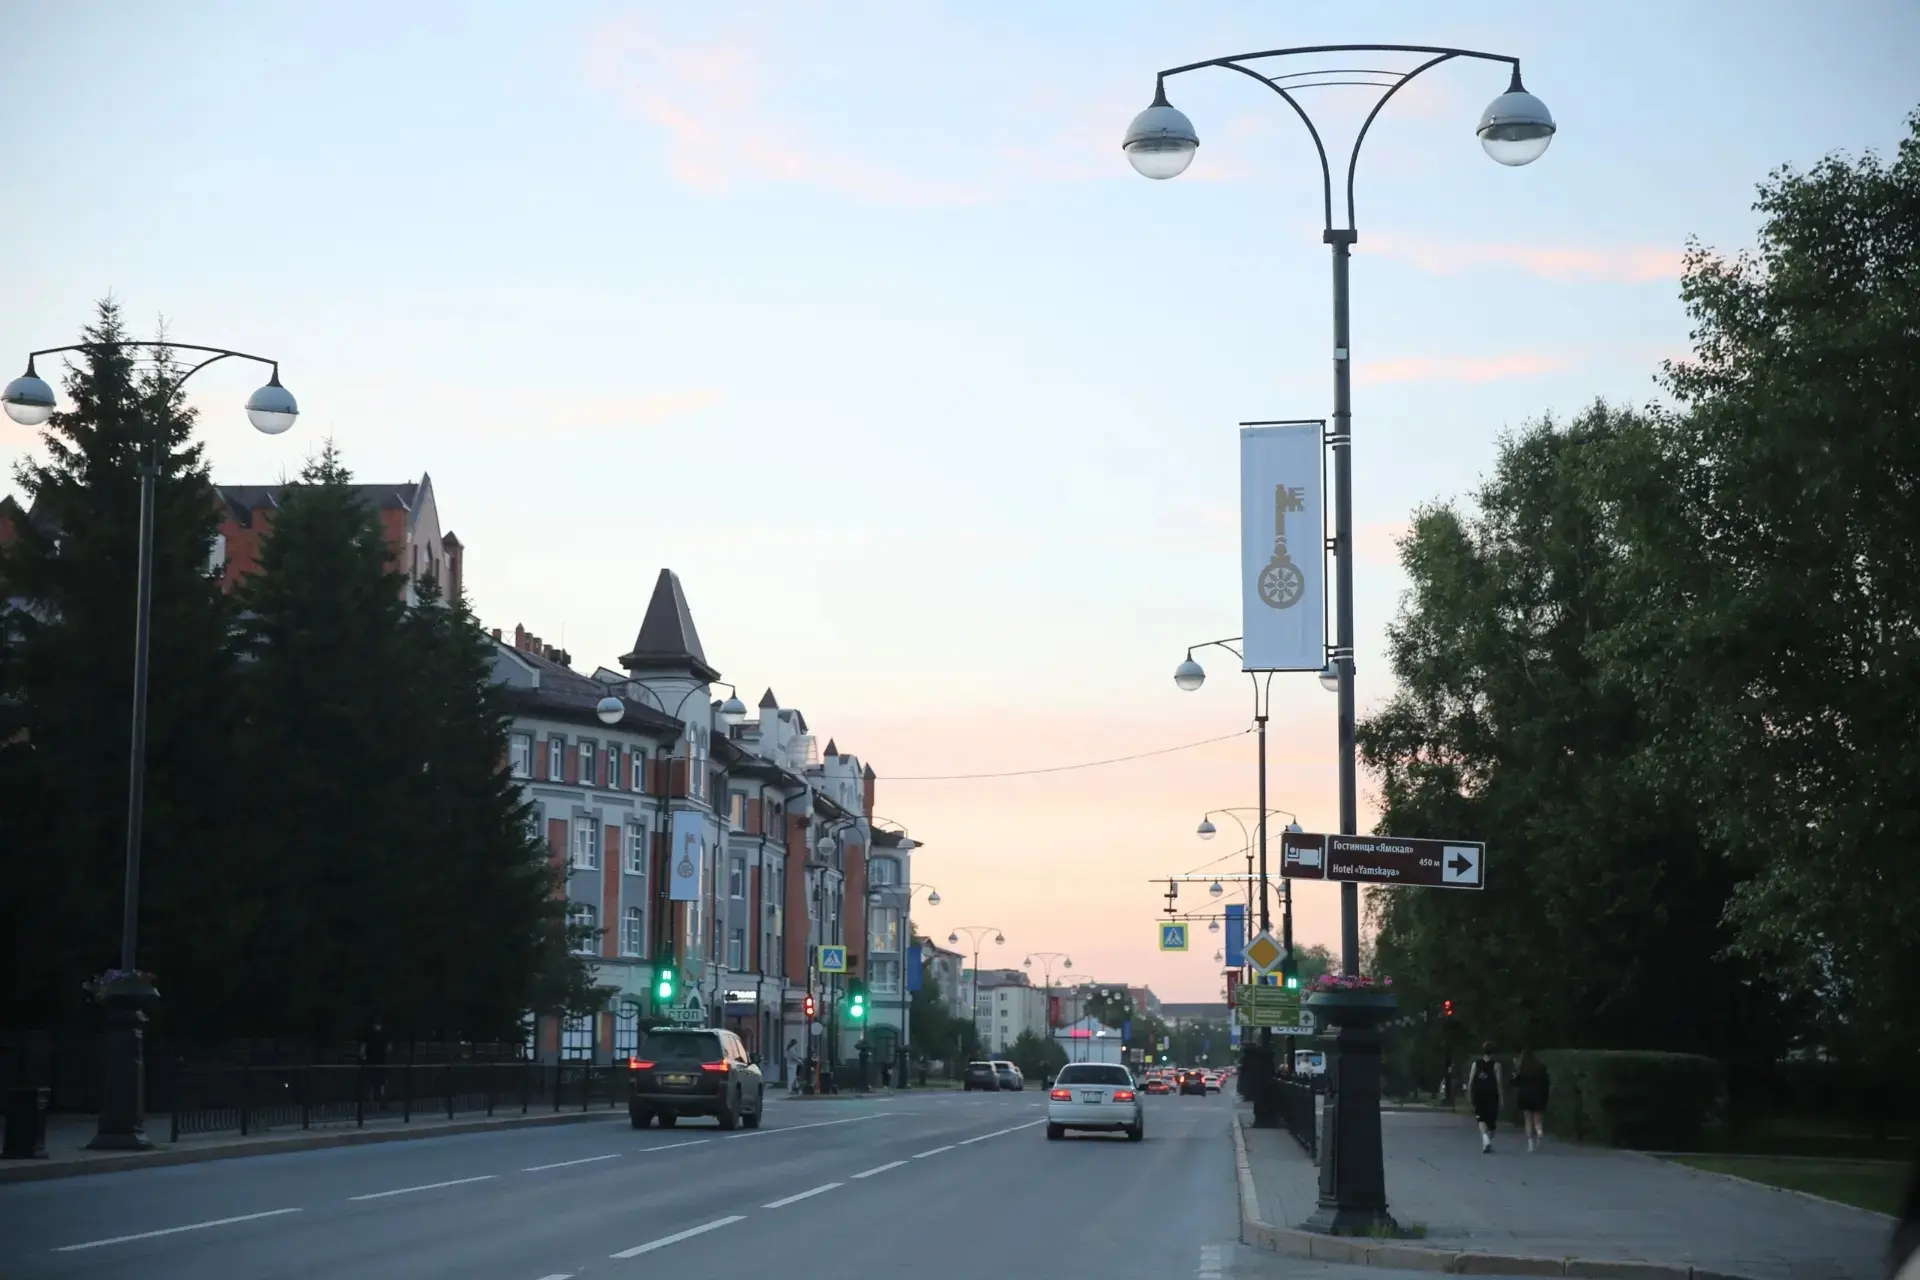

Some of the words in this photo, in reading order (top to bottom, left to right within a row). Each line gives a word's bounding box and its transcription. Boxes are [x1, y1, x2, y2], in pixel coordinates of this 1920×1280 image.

[1333, 840, 1374, 853] Гостиница
[1375, 843, 1414, 854] «Ямская»
[1418, 858, 1433, 867] 450
[1332, 864, 1353, 874] Hotel
[1354, 865, 1400, 878] «Yamskaya»
[668, 1010, 699, 1020] СТОП
